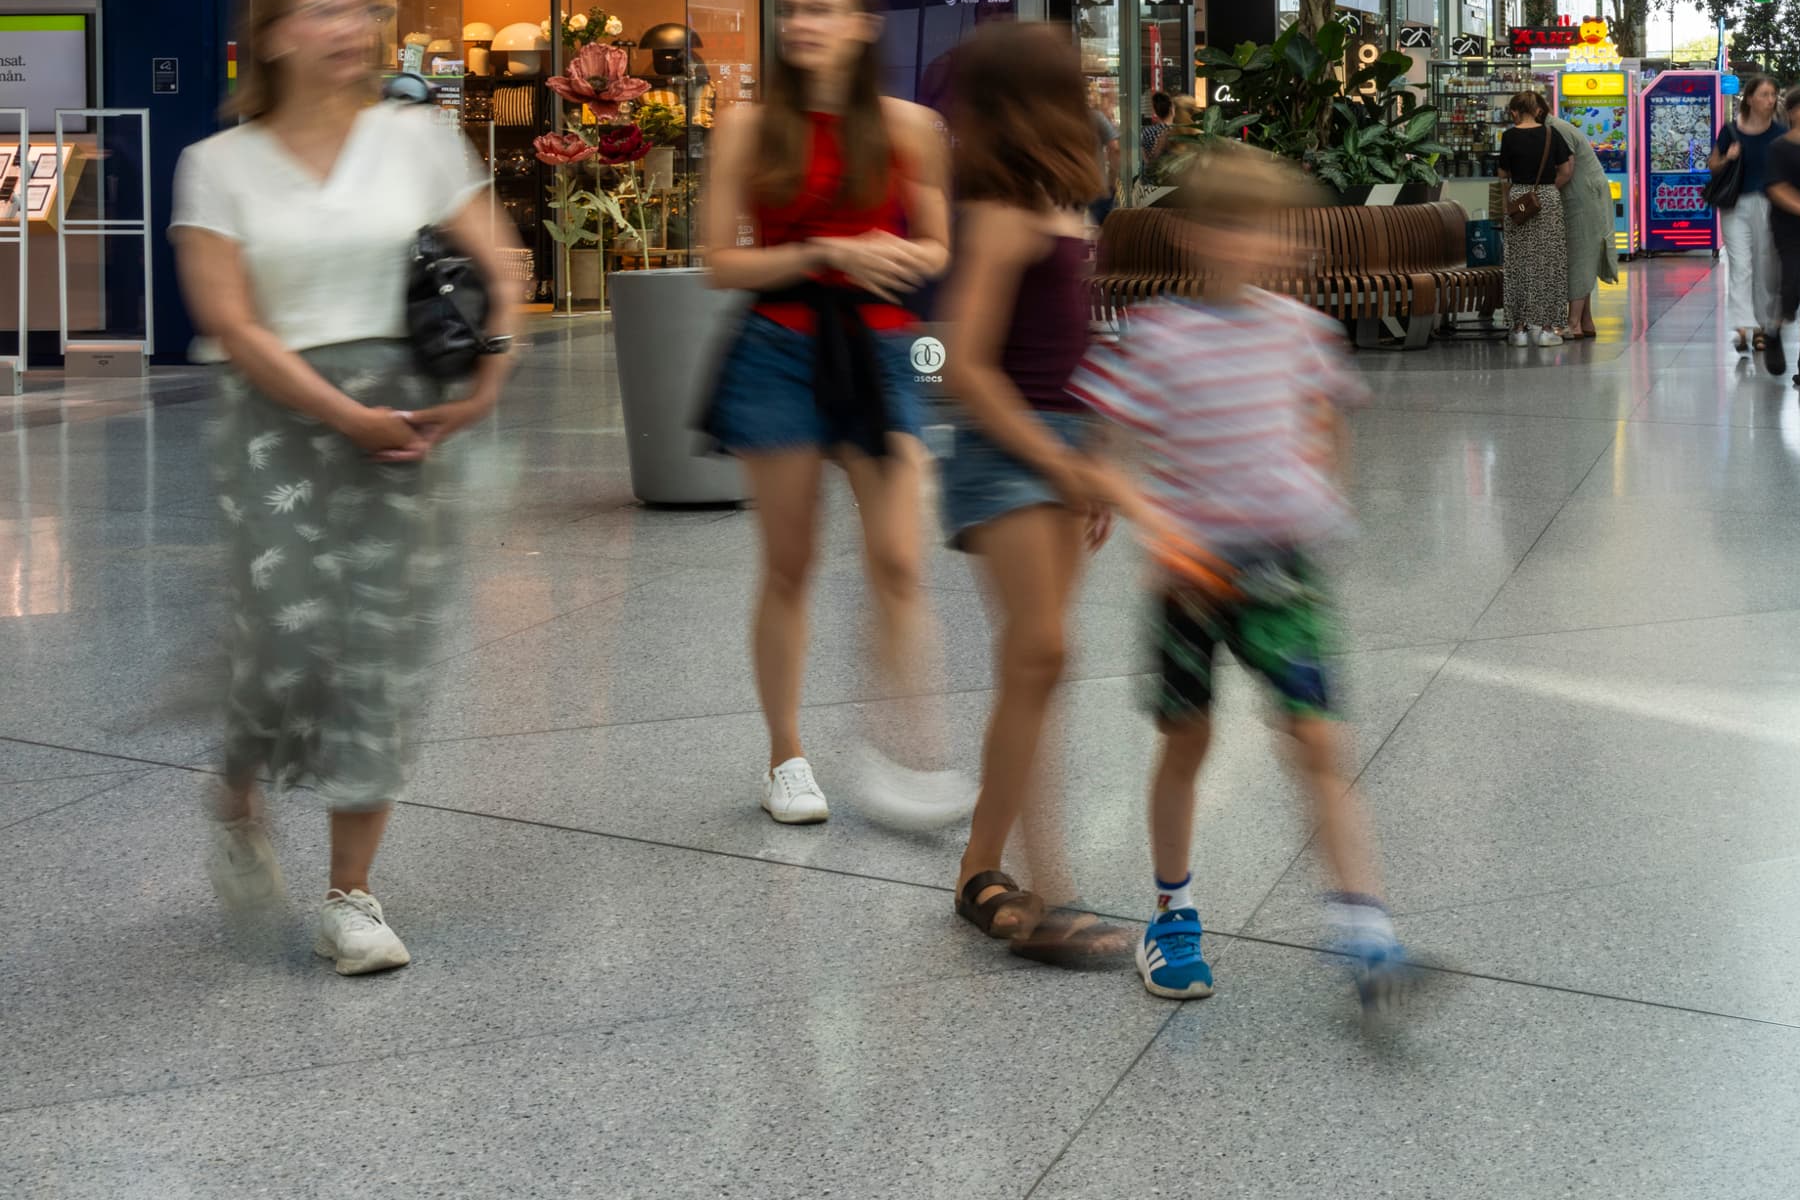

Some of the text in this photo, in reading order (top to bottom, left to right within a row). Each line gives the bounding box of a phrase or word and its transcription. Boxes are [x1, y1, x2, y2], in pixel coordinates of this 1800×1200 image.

[1658, 185, 1705, 197] SWEET
[1657, 198, 1705, 210] TREAT
[913, 375, 943, 383] asecs
